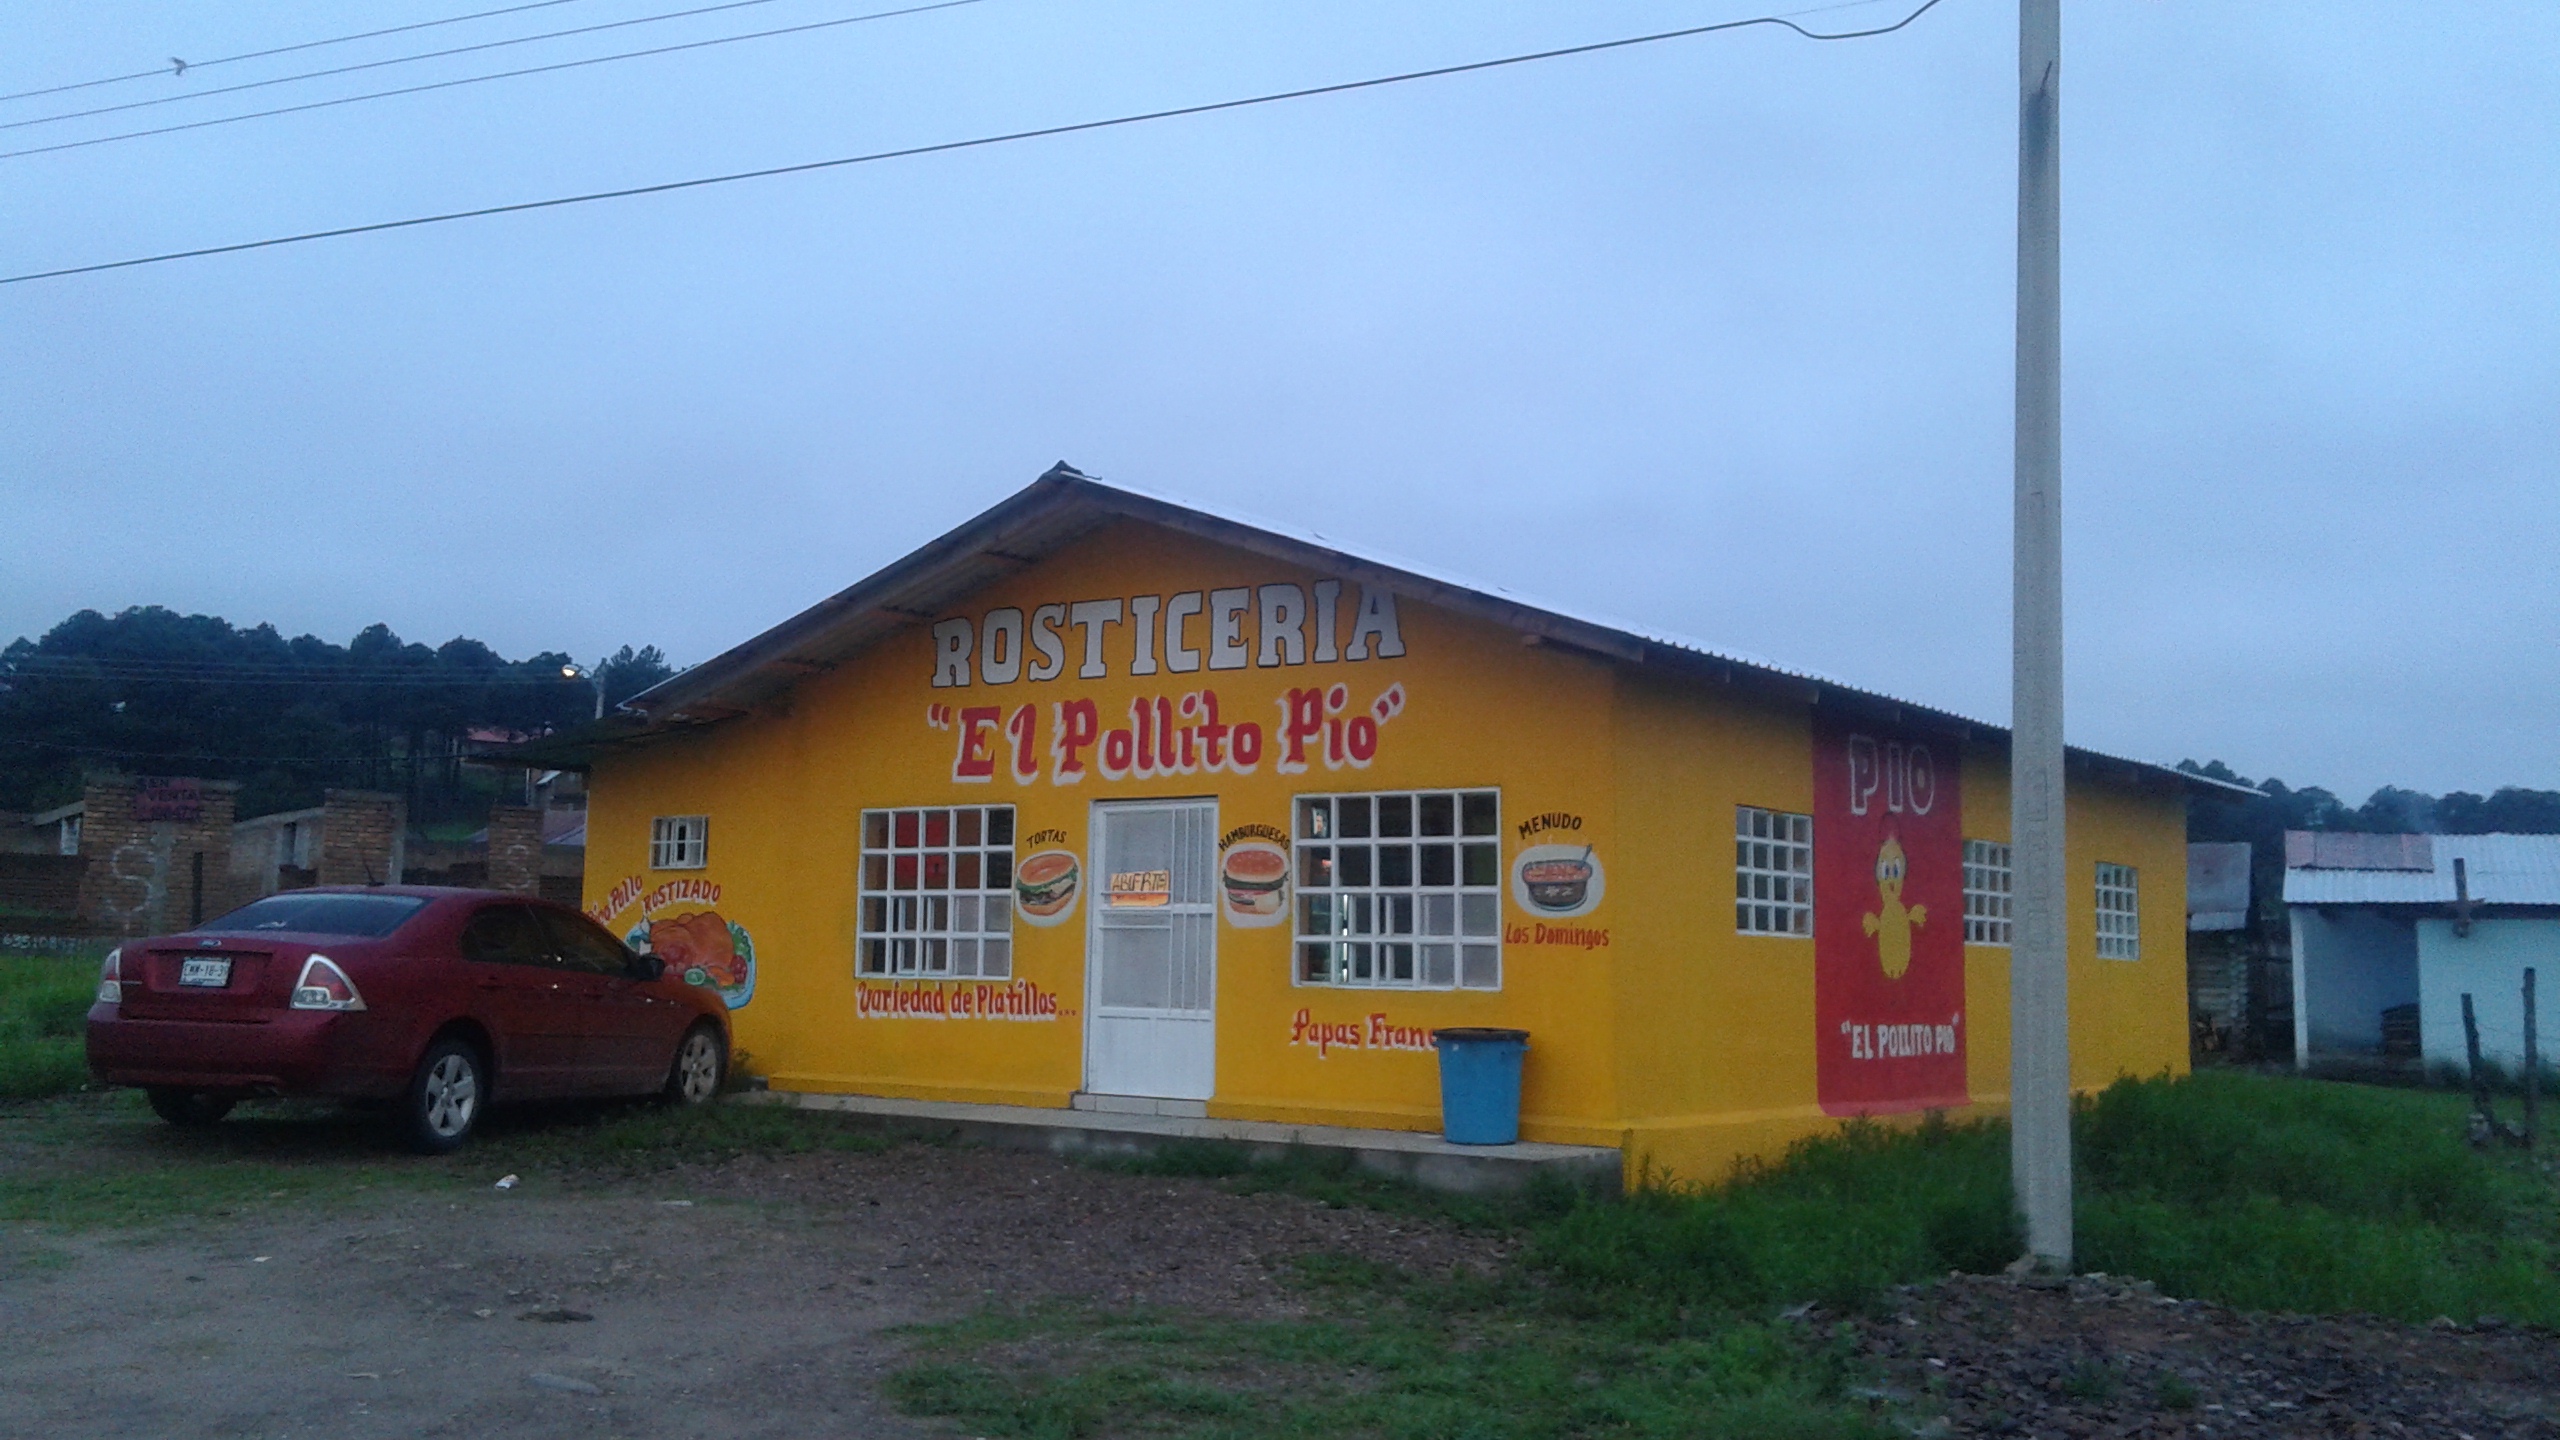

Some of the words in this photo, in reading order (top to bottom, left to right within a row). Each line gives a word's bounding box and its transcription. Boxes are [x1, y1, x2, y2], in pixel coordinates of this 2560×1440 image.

[930, 579, 1406, 688] ROSTICERIA
[1053, 689, 1263, 788] Pollito
[1849, 733, 1935, 816] PIO
[1026, 829, 1068, 849] TORTAS
[1218, 823, 1290, 852] HAMBURGUESAS
[1518, 811, 1583, 840] MENUDO
[608, 875, 643, 919] Pollo
[642, 878, 722, 915] ROSTIZADO
[1505, 922, 1529, 944] Los
[1534, 922, 1610, 950] Domingos
[856, 979, 946, 1021] Variedad
[949, 980, 973, 1021] de
[1289, 1007, 1361, 1059] Papas
[1878, 1024, 1933, 1058] POLLITO
